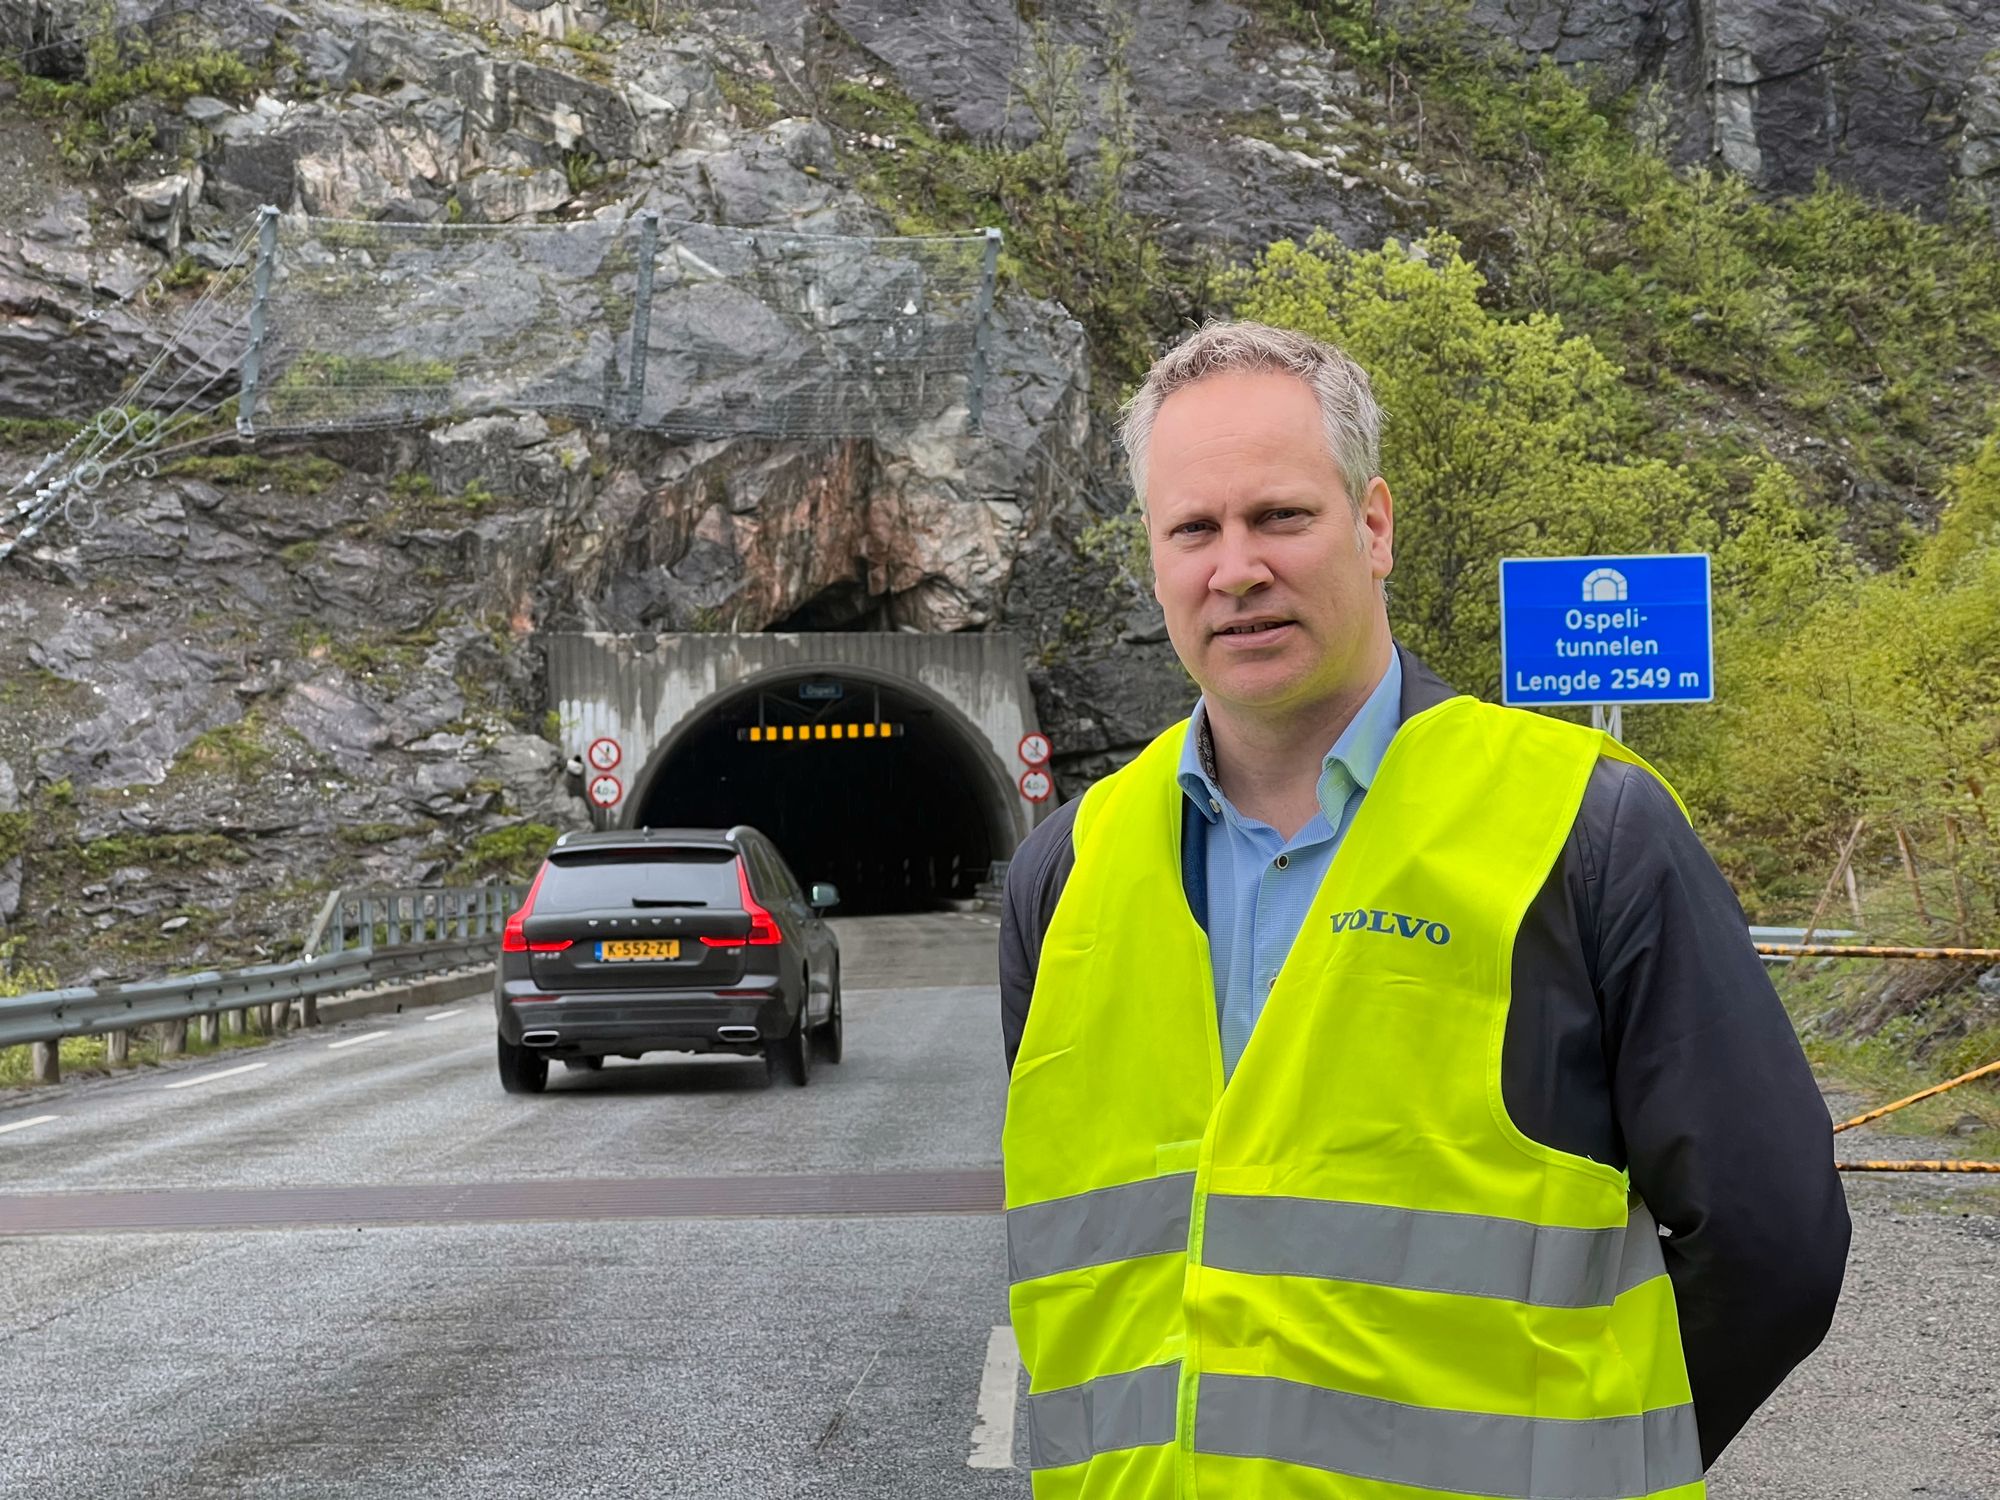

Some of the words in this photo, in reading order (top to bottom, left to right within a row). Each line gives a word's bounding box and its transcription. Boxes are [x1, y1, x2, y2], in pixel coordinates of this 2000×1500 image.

[1565, 608, 1648, 634] Ospeli-
[1555, 635, 1659, 657] tunnelen
[1516, 669, 1601, 696] Lengde
[1610, 667, 1671, 690] 2549
[1678, 671, 1699, 688] m
[1329, 908, 1451, 946] VOLVO
[607, 941, 673, 956] K-552-ZT
